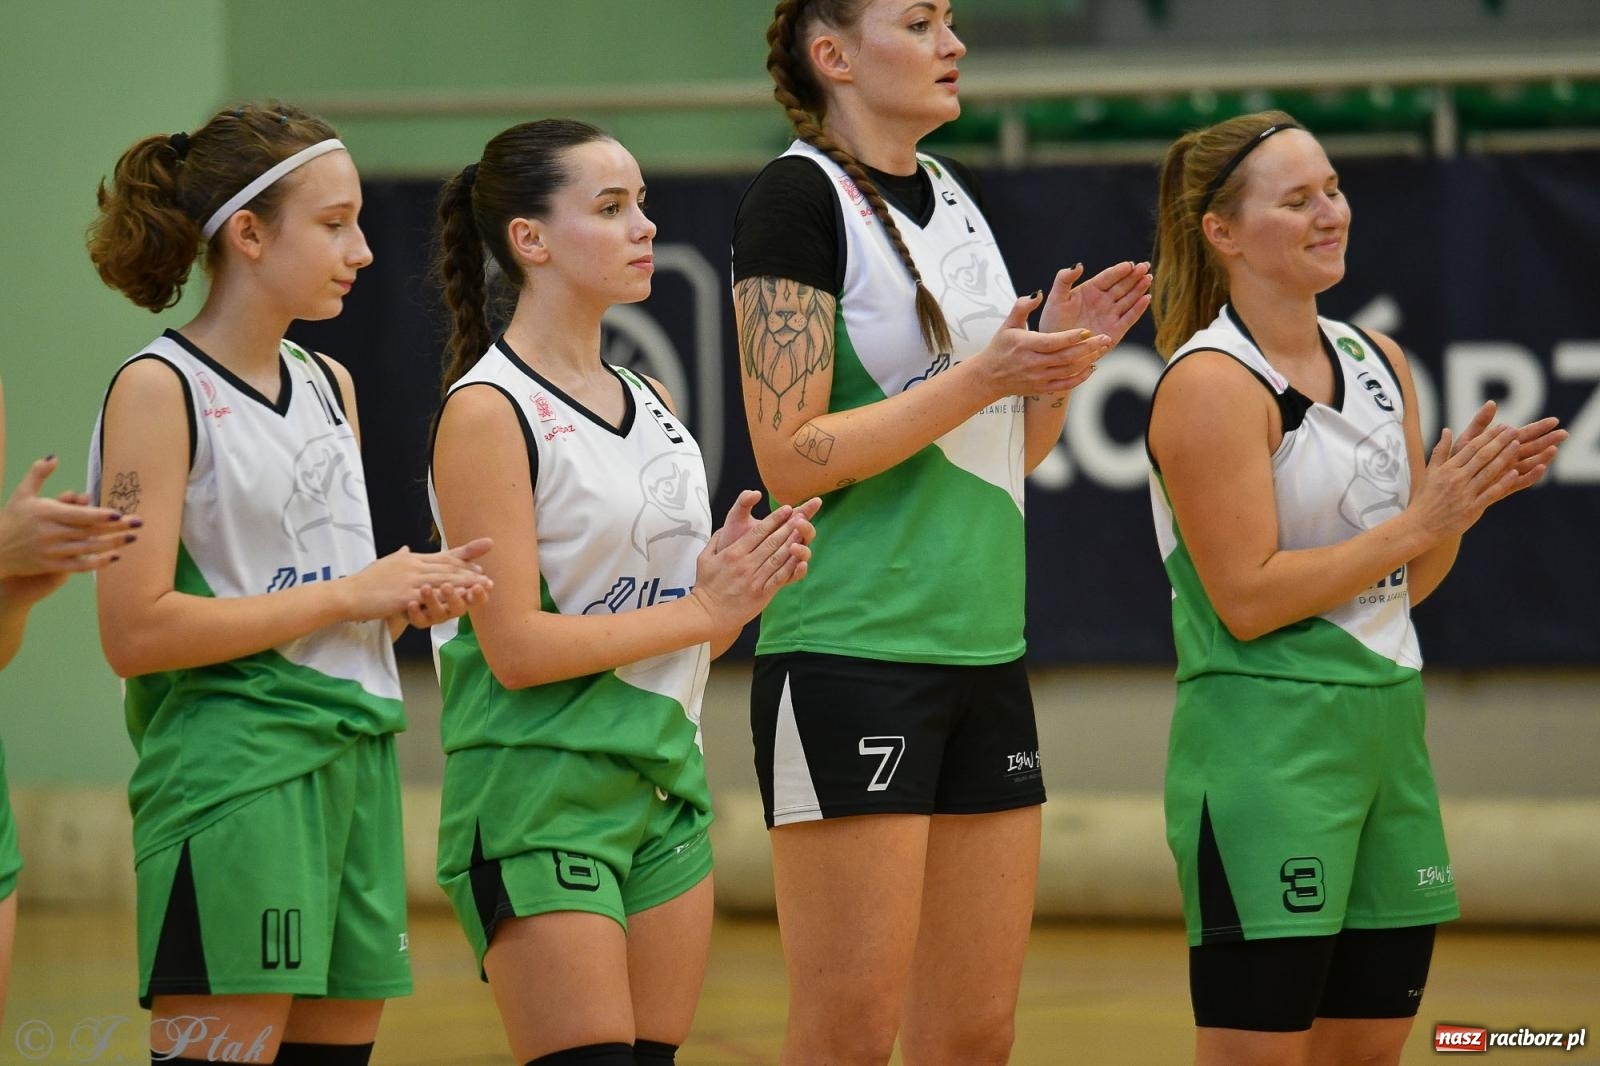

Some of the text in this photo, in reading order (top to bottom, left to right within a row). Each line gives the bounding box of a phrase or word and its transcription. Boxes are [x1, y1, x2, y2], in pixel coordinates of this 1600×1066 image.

[858, 735, 906, 792] 7
[552, 850, 600, 892] 8
[1280, 857, 1326, 913] 3
[262, 908, 302, 970] 11
